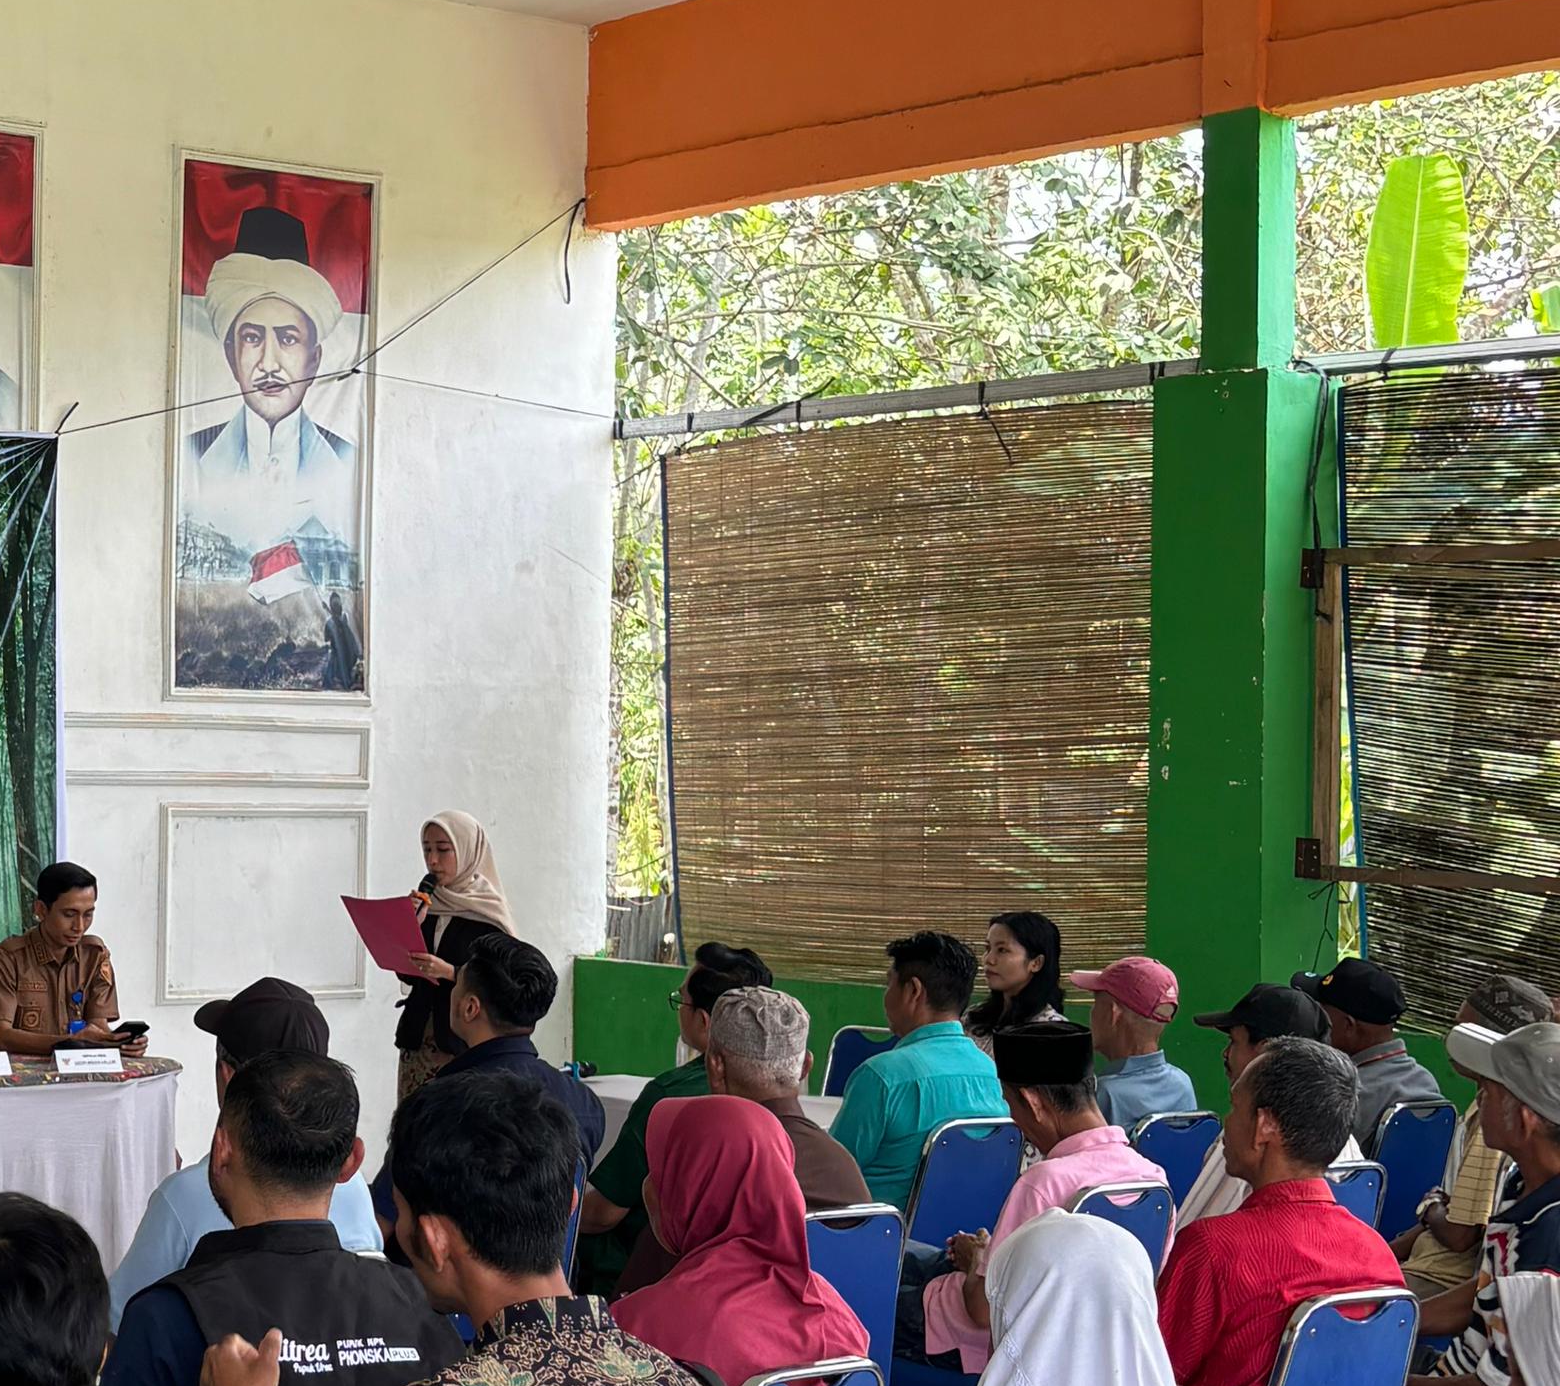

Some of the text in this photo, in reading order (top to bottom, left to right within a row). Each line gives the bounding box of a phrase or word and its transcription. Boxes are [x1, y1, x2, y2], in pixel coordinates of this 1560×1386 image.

[278, 1338, 330, 1362] itrea
[338, 1347, 418, 1366] PHONSKA PLUS
